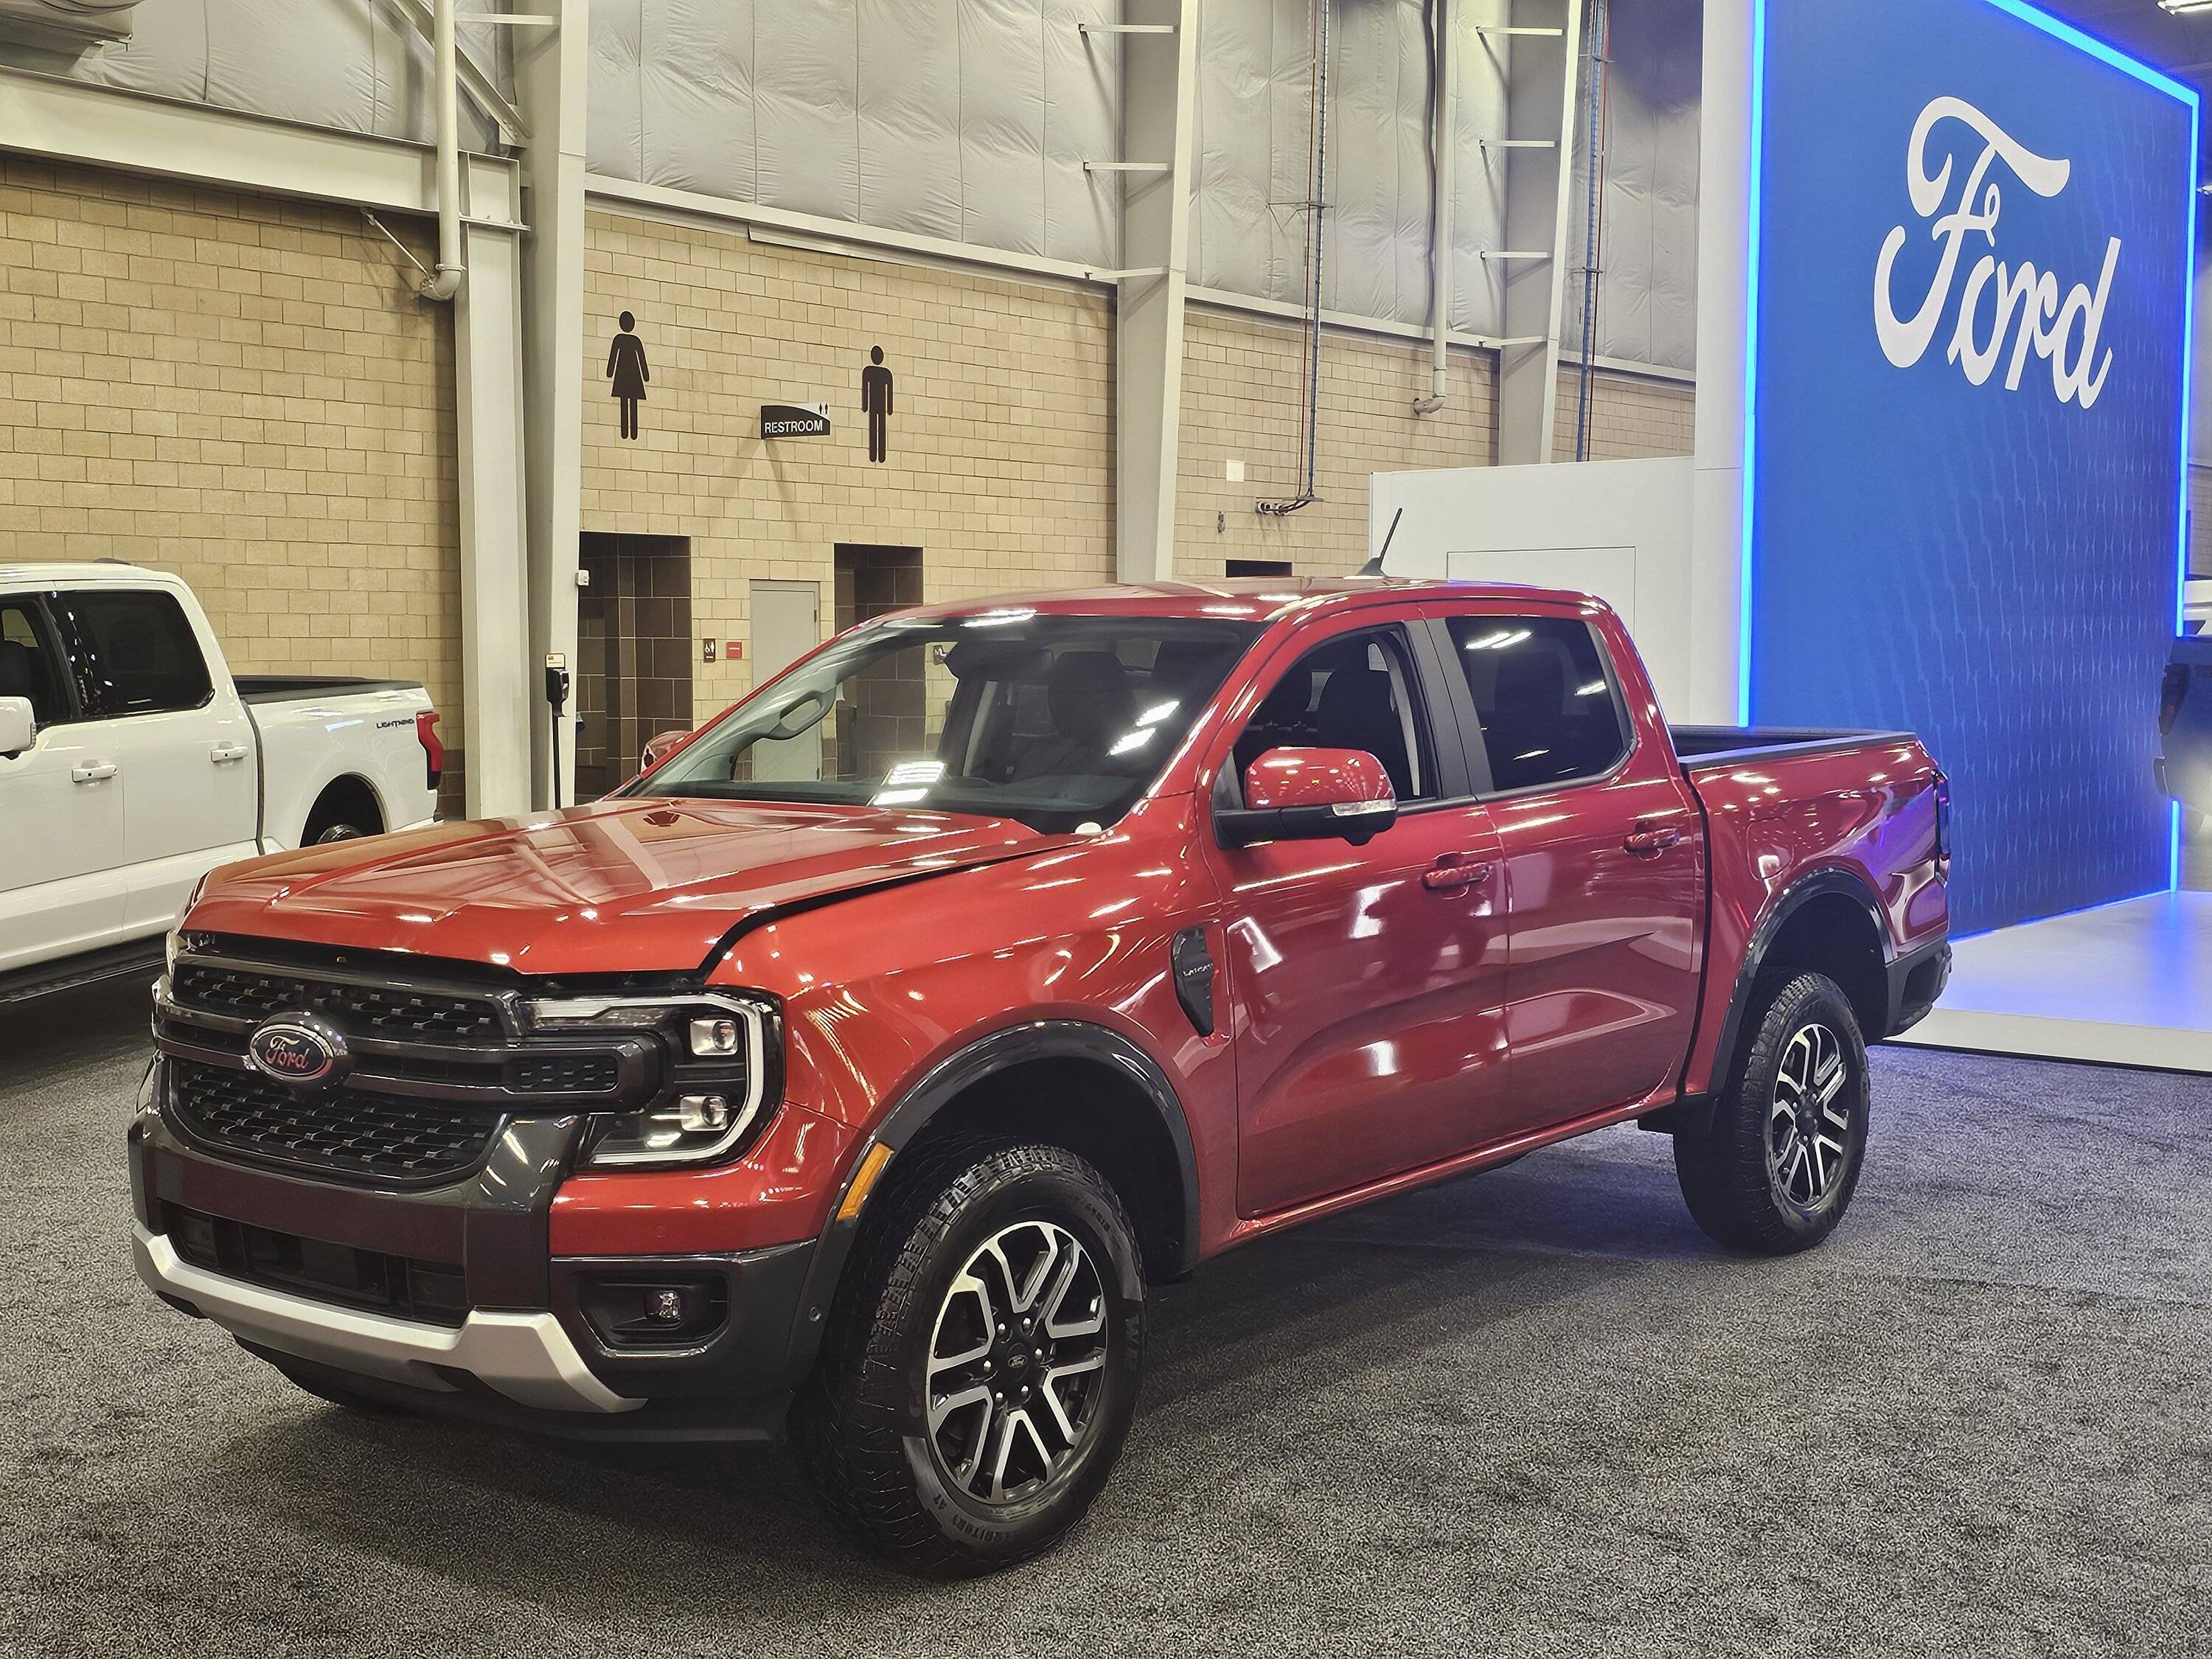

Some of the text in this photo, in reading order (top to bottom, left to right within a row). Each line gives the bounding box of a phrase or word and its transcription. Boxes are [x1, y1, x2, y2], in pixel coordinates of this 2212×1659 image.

[1874, 96, 2121, 408] Ford
[765, 420, 823, 434] RESTROOM
[265, 1035, 310, 1068] Ford
